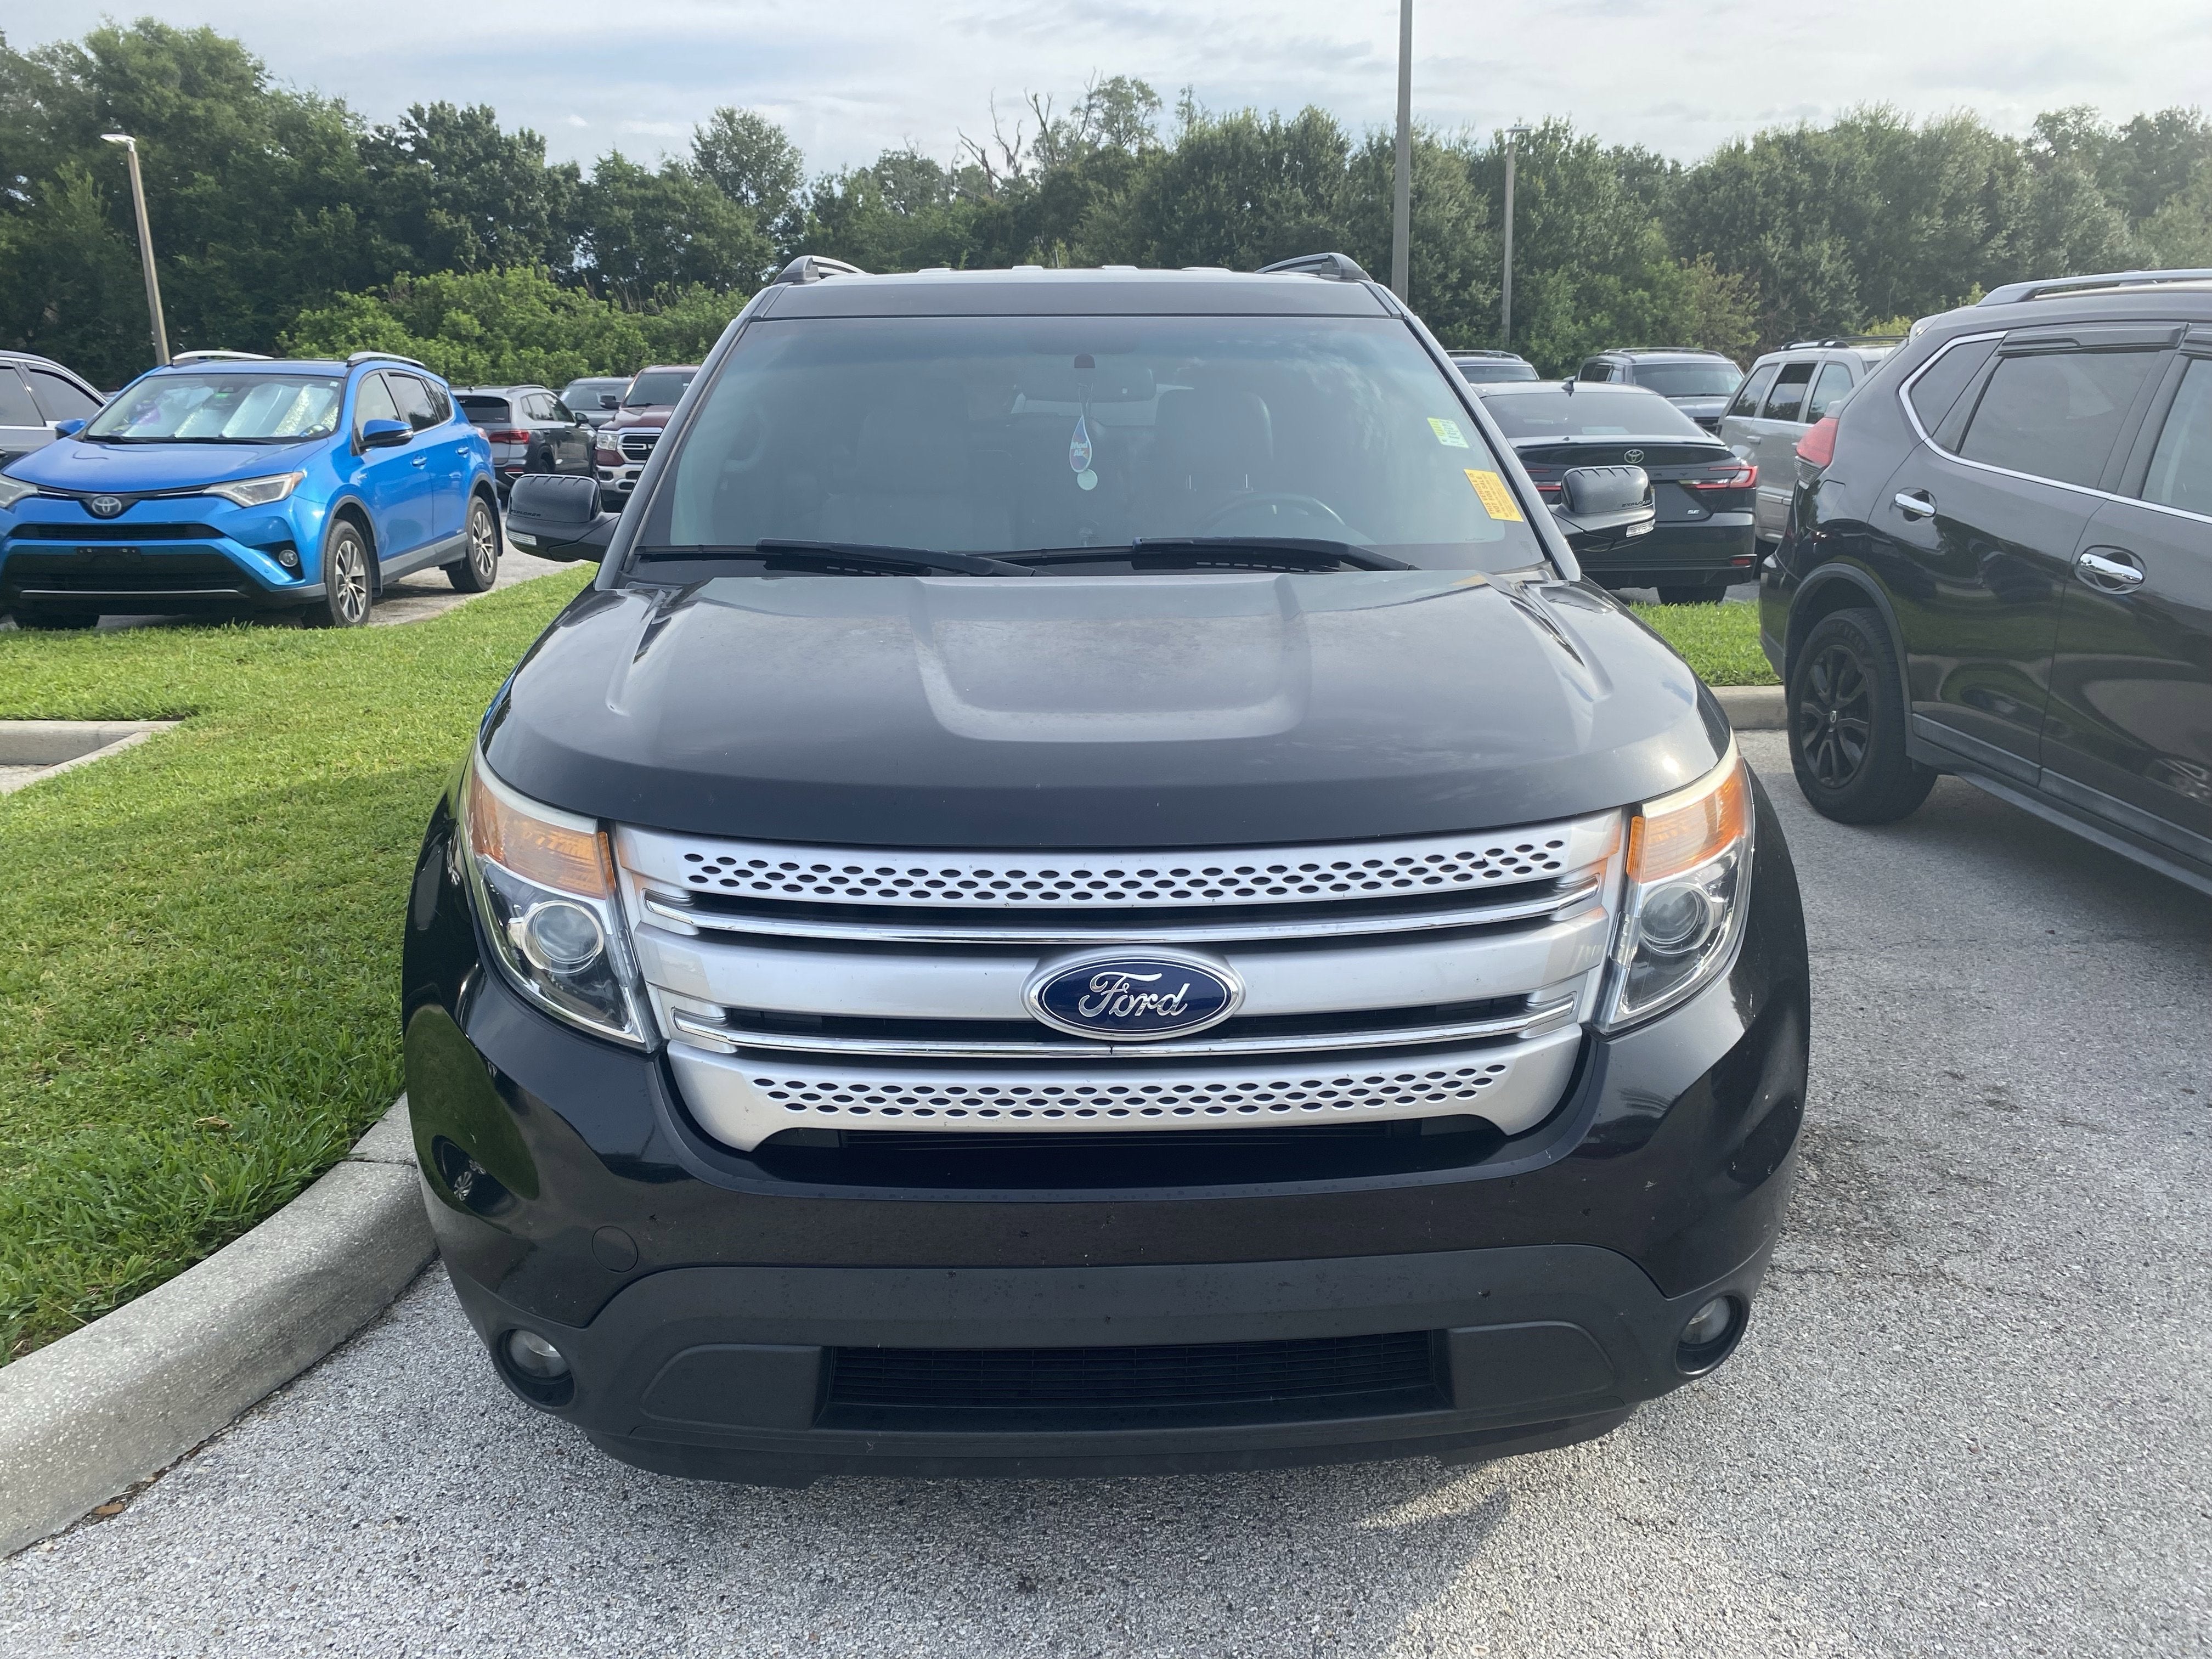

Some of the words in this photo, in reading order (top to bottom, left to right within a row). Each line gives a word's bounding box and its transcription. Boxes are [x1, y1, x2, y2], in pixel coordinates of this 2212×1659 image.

[1476, 476, 1488, 489] SALE
[1471, 480, 1488, 501] VEHICLE
[1485, 490, 1495, 501] FOR
[1485, 503, 1496, 515] THIS
[1491, 503, 1502, 513] NOT
[1079, 972, 1191, 1018] Ford
